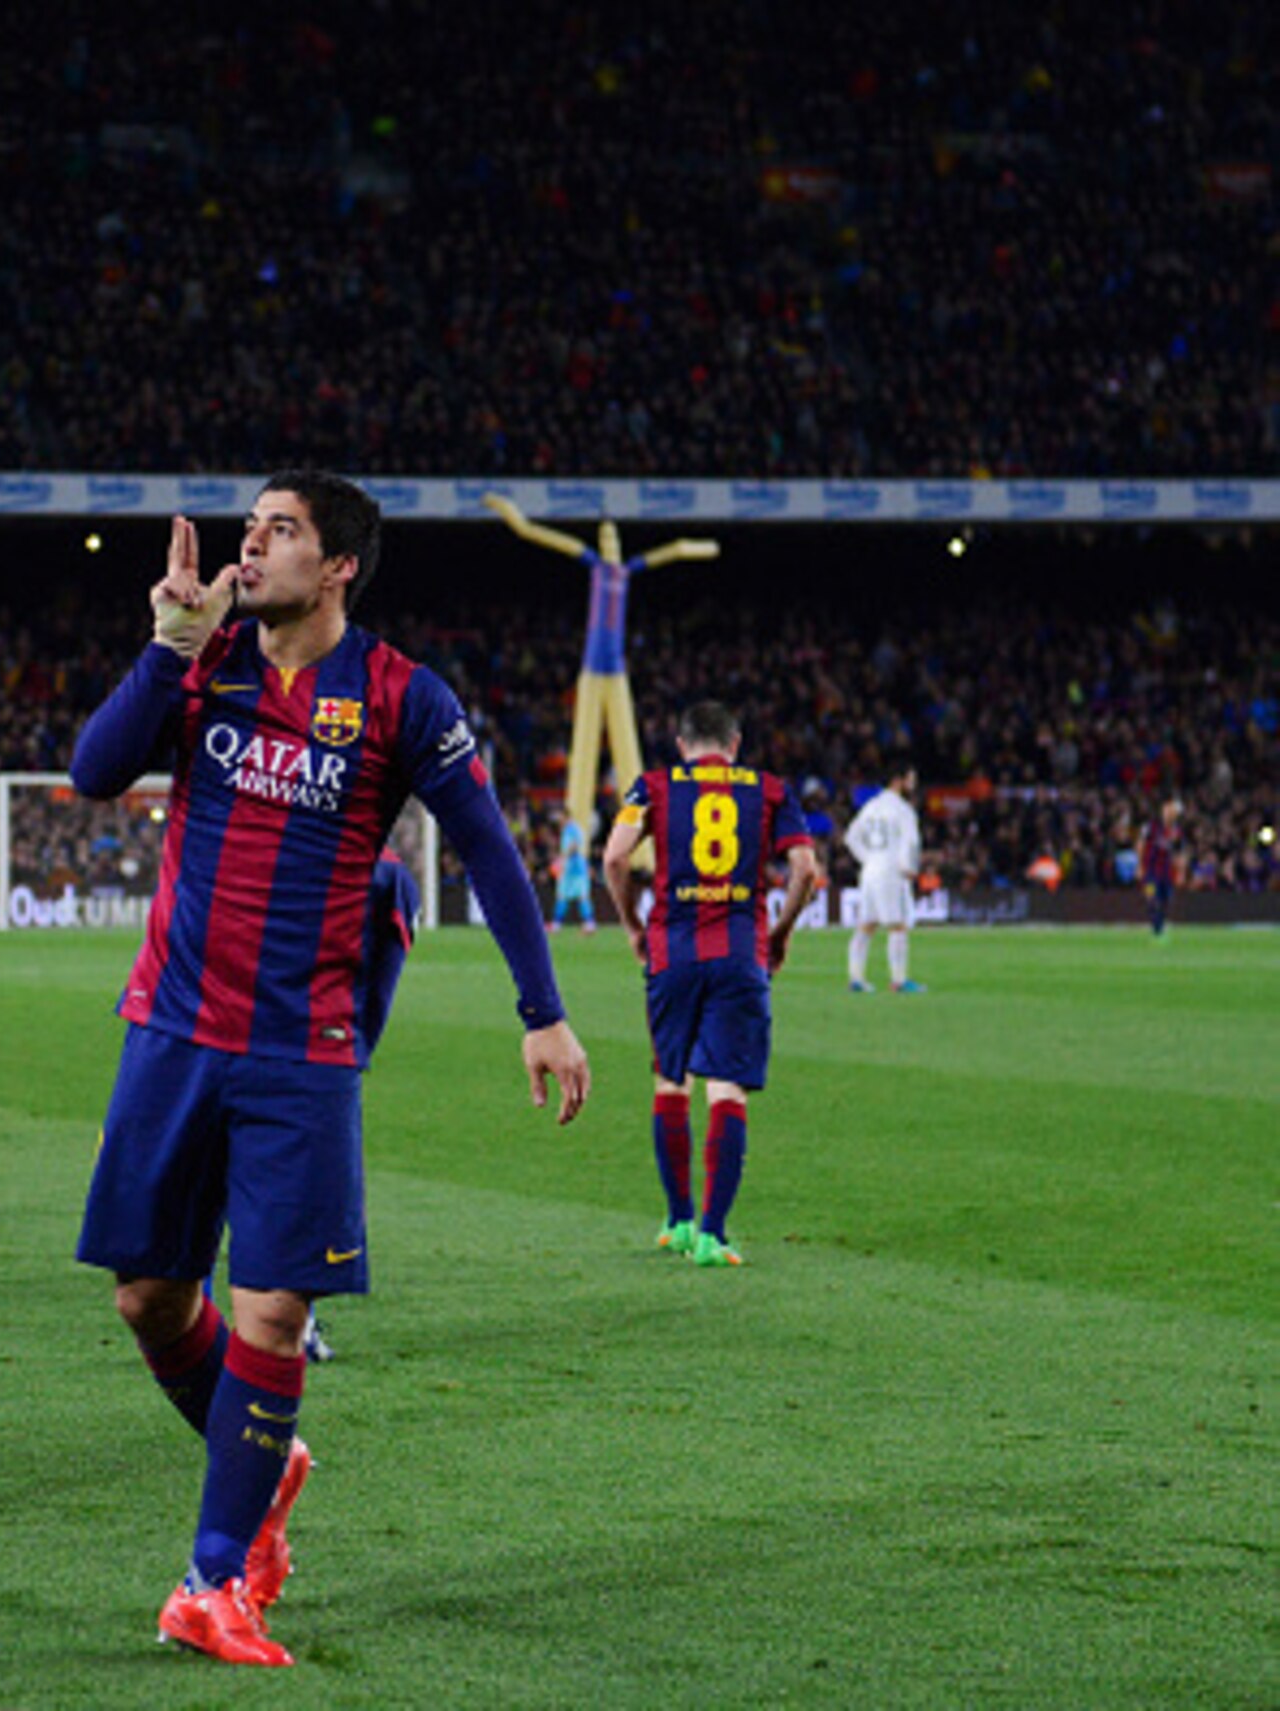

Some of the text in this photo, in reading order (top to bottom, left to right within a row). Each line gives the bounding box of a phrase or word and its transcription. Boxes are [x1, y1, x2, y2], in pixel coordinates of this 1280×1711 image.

[205, 723, 347, 790] QATAR
[223, 767, 338, 811] AIRWAYS
[692, 792, 739, 877] 8
